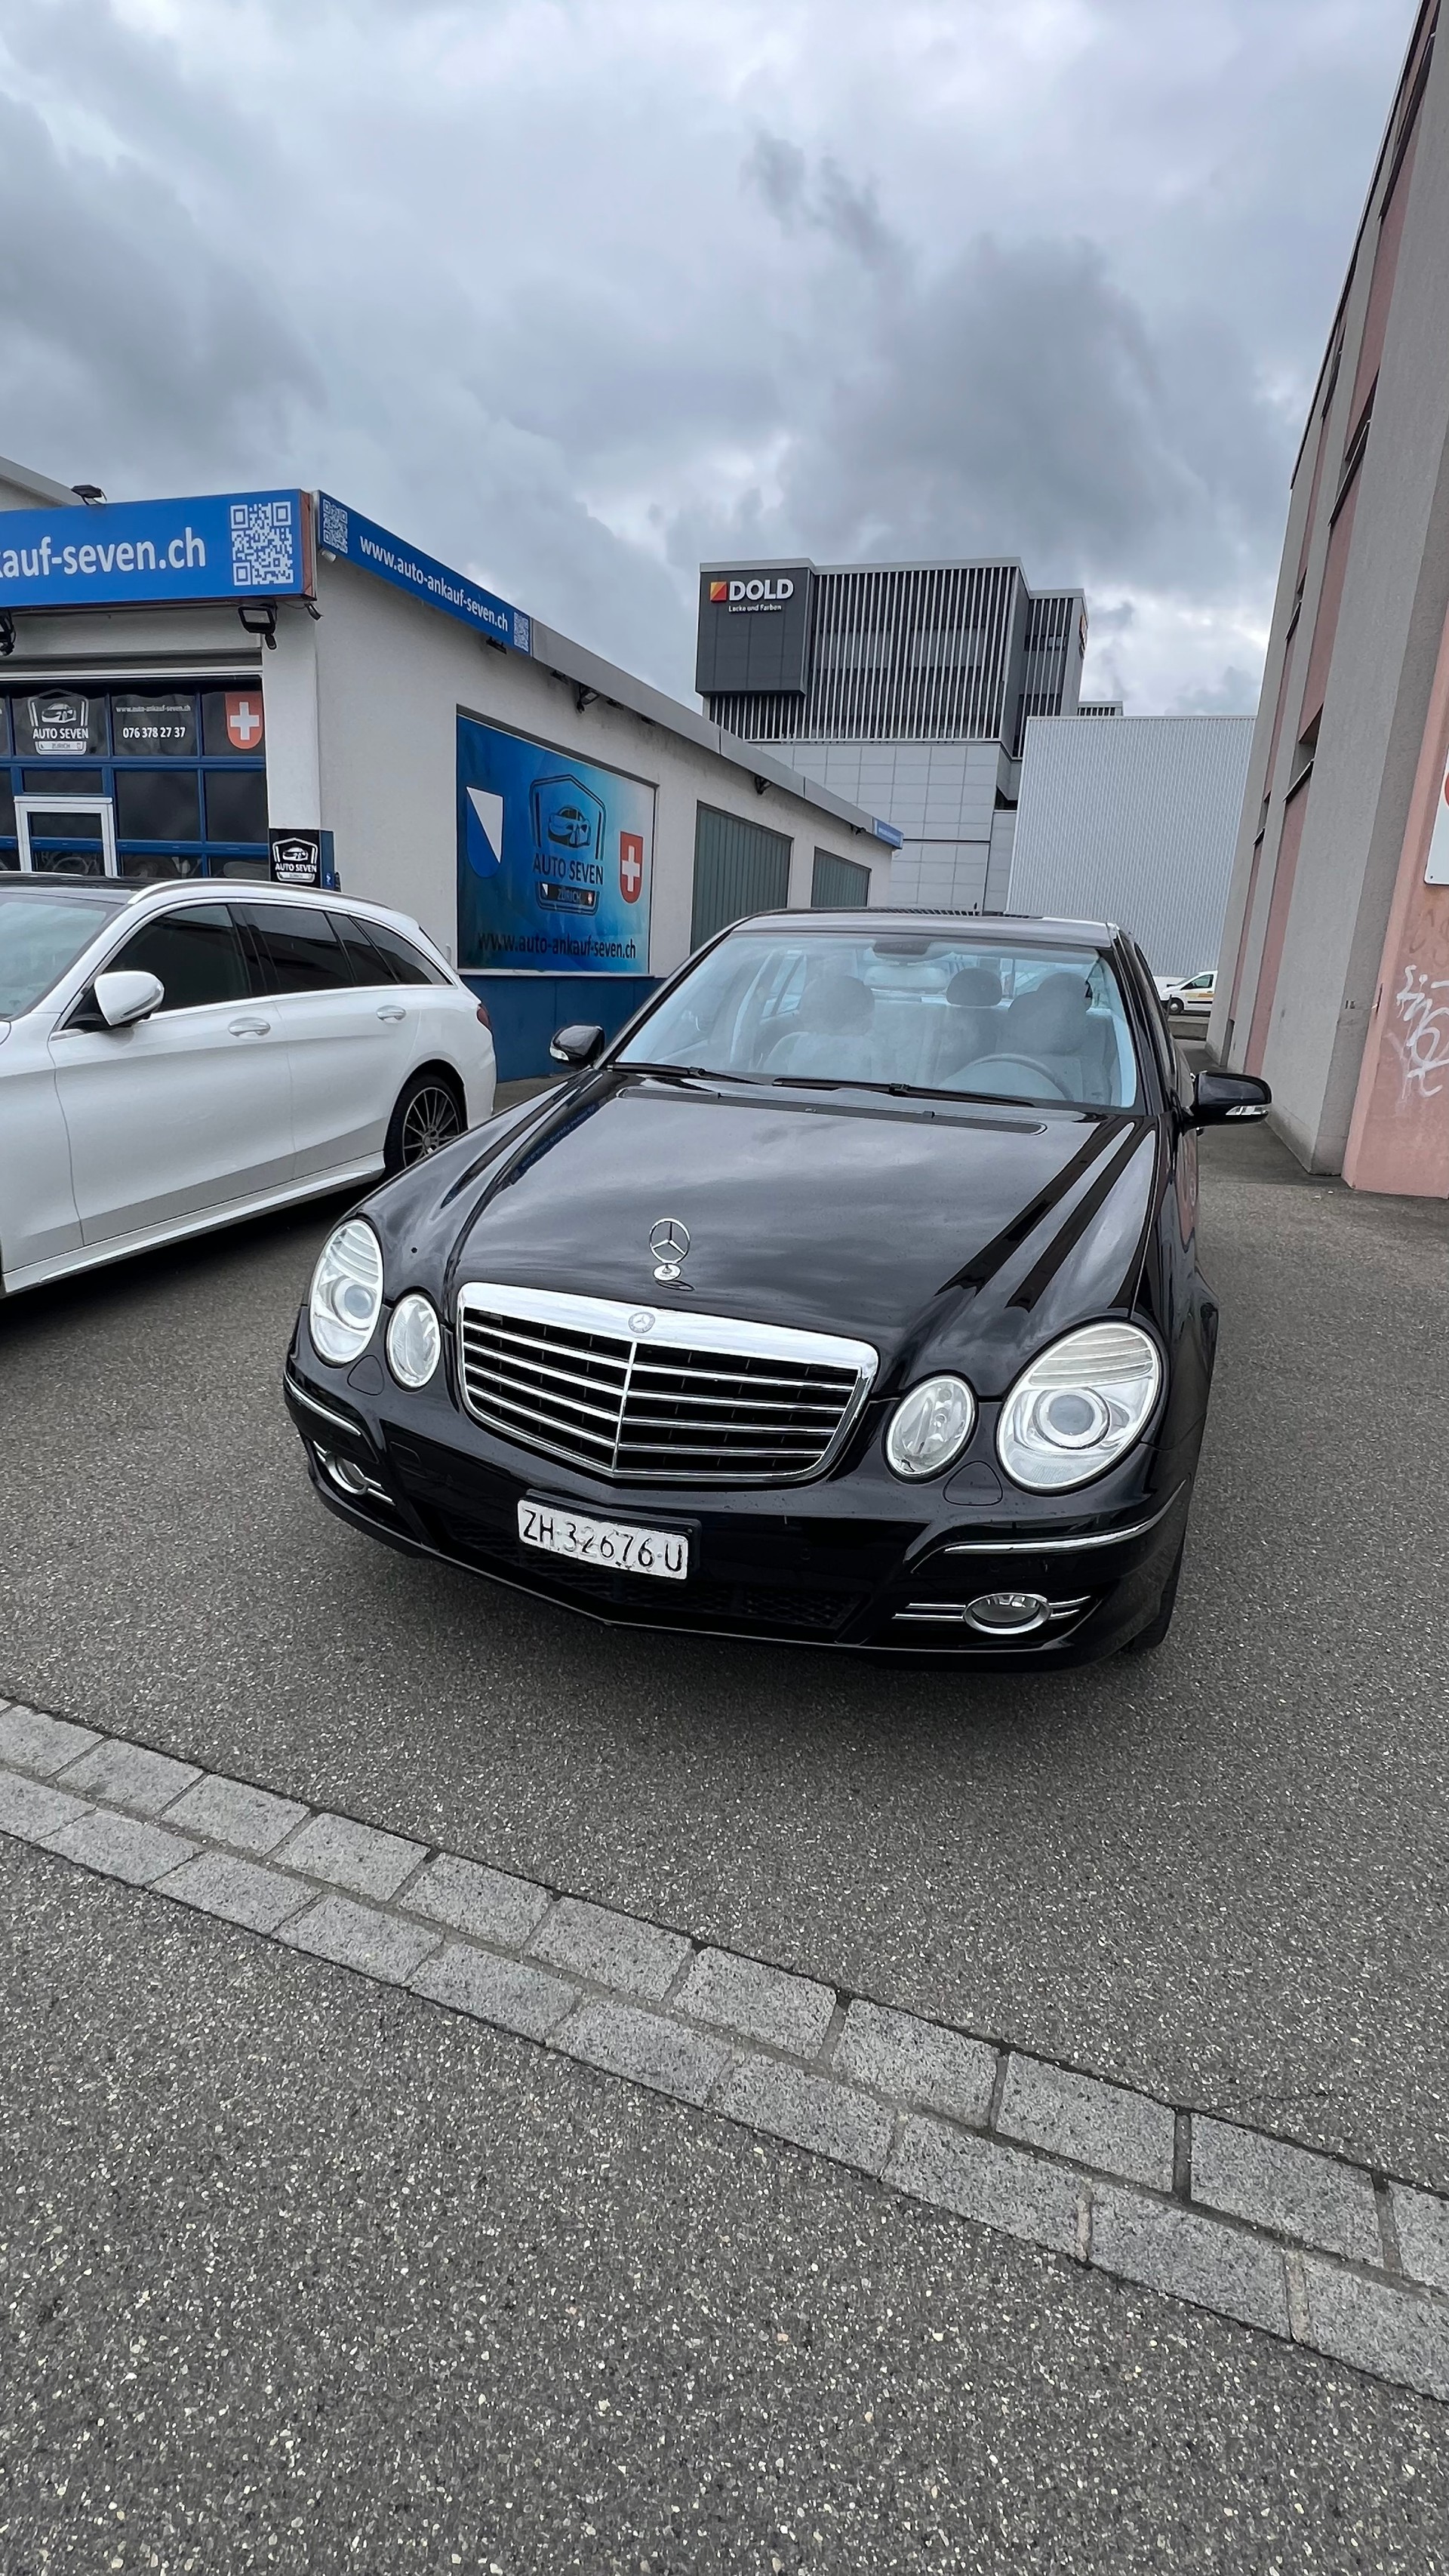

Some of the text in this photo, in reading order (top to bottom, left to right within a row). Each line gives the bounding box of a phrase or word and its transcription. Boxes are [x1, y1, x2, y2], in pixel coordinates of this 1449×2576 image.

[0, 527, 206, 579] auf-seven.ch
[359, 535, 509, 632] www.auto-ankauf-seven.ch
[729, 579, 794, 601] DOLD
[32, 728, 89, 739] AUTO SEVEN
[123, 727, 186, 738] 076 378 27 37
[275, 863, 317, 873] AUTO SEVEN
[533, 852, 604, 885] AUTO SEVEN
[478, 933, 636, 959] www.auto-ankauf-seven.ch
